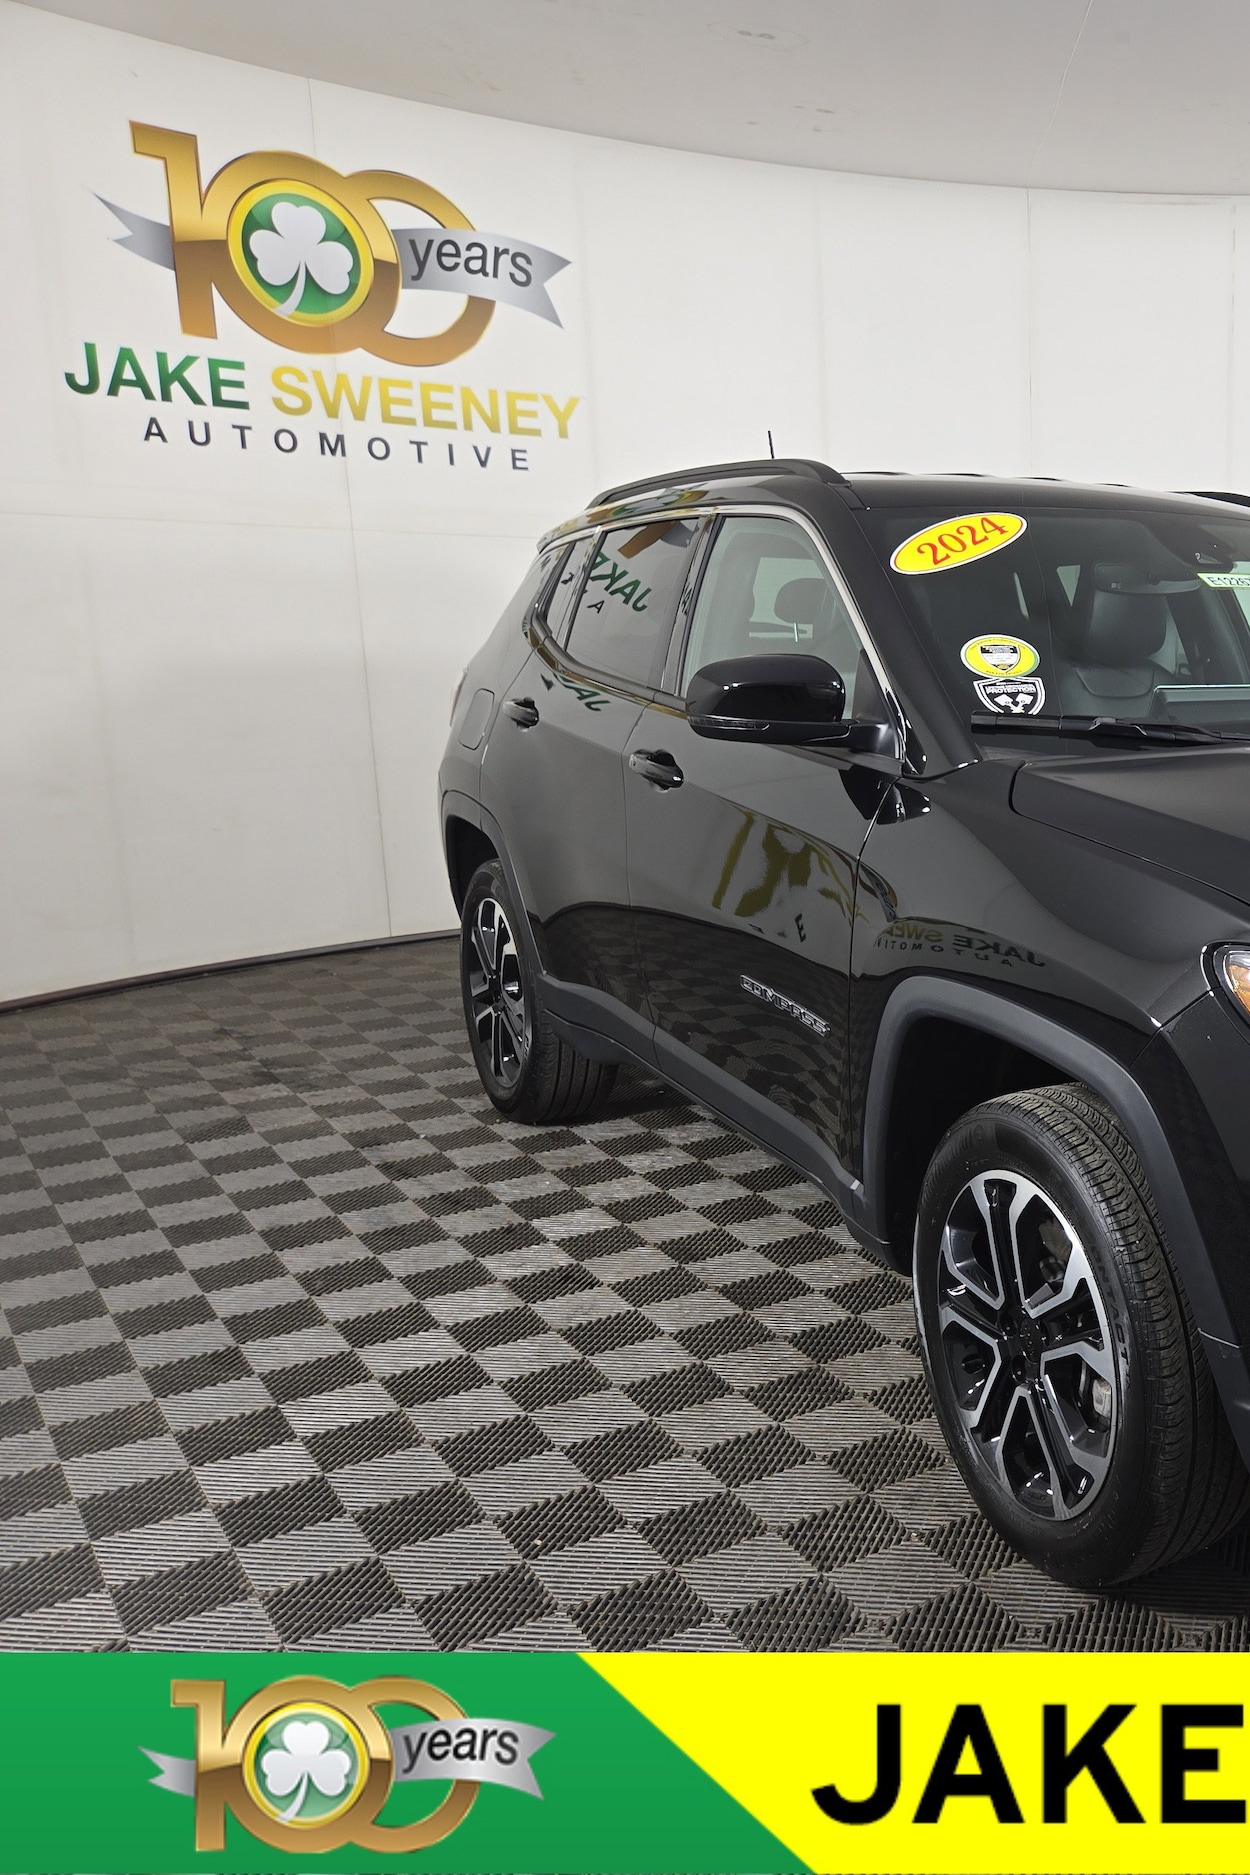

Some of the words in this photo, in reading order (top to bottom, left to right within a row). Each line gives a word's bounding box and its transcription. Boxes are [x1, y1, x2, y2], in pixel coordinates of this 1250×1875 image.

[129, 120, 497, 367] 100
[407, 234, 534, 288] years
[64, 341, 251, 411] JAKE
[271, 365, 583, 440] SWEENEY
[143, 416, 530, 472] AUTOMOTIVE
[917, 517, 1009, 566] 2024
[740, 974, 831, 1037] COMPASS
